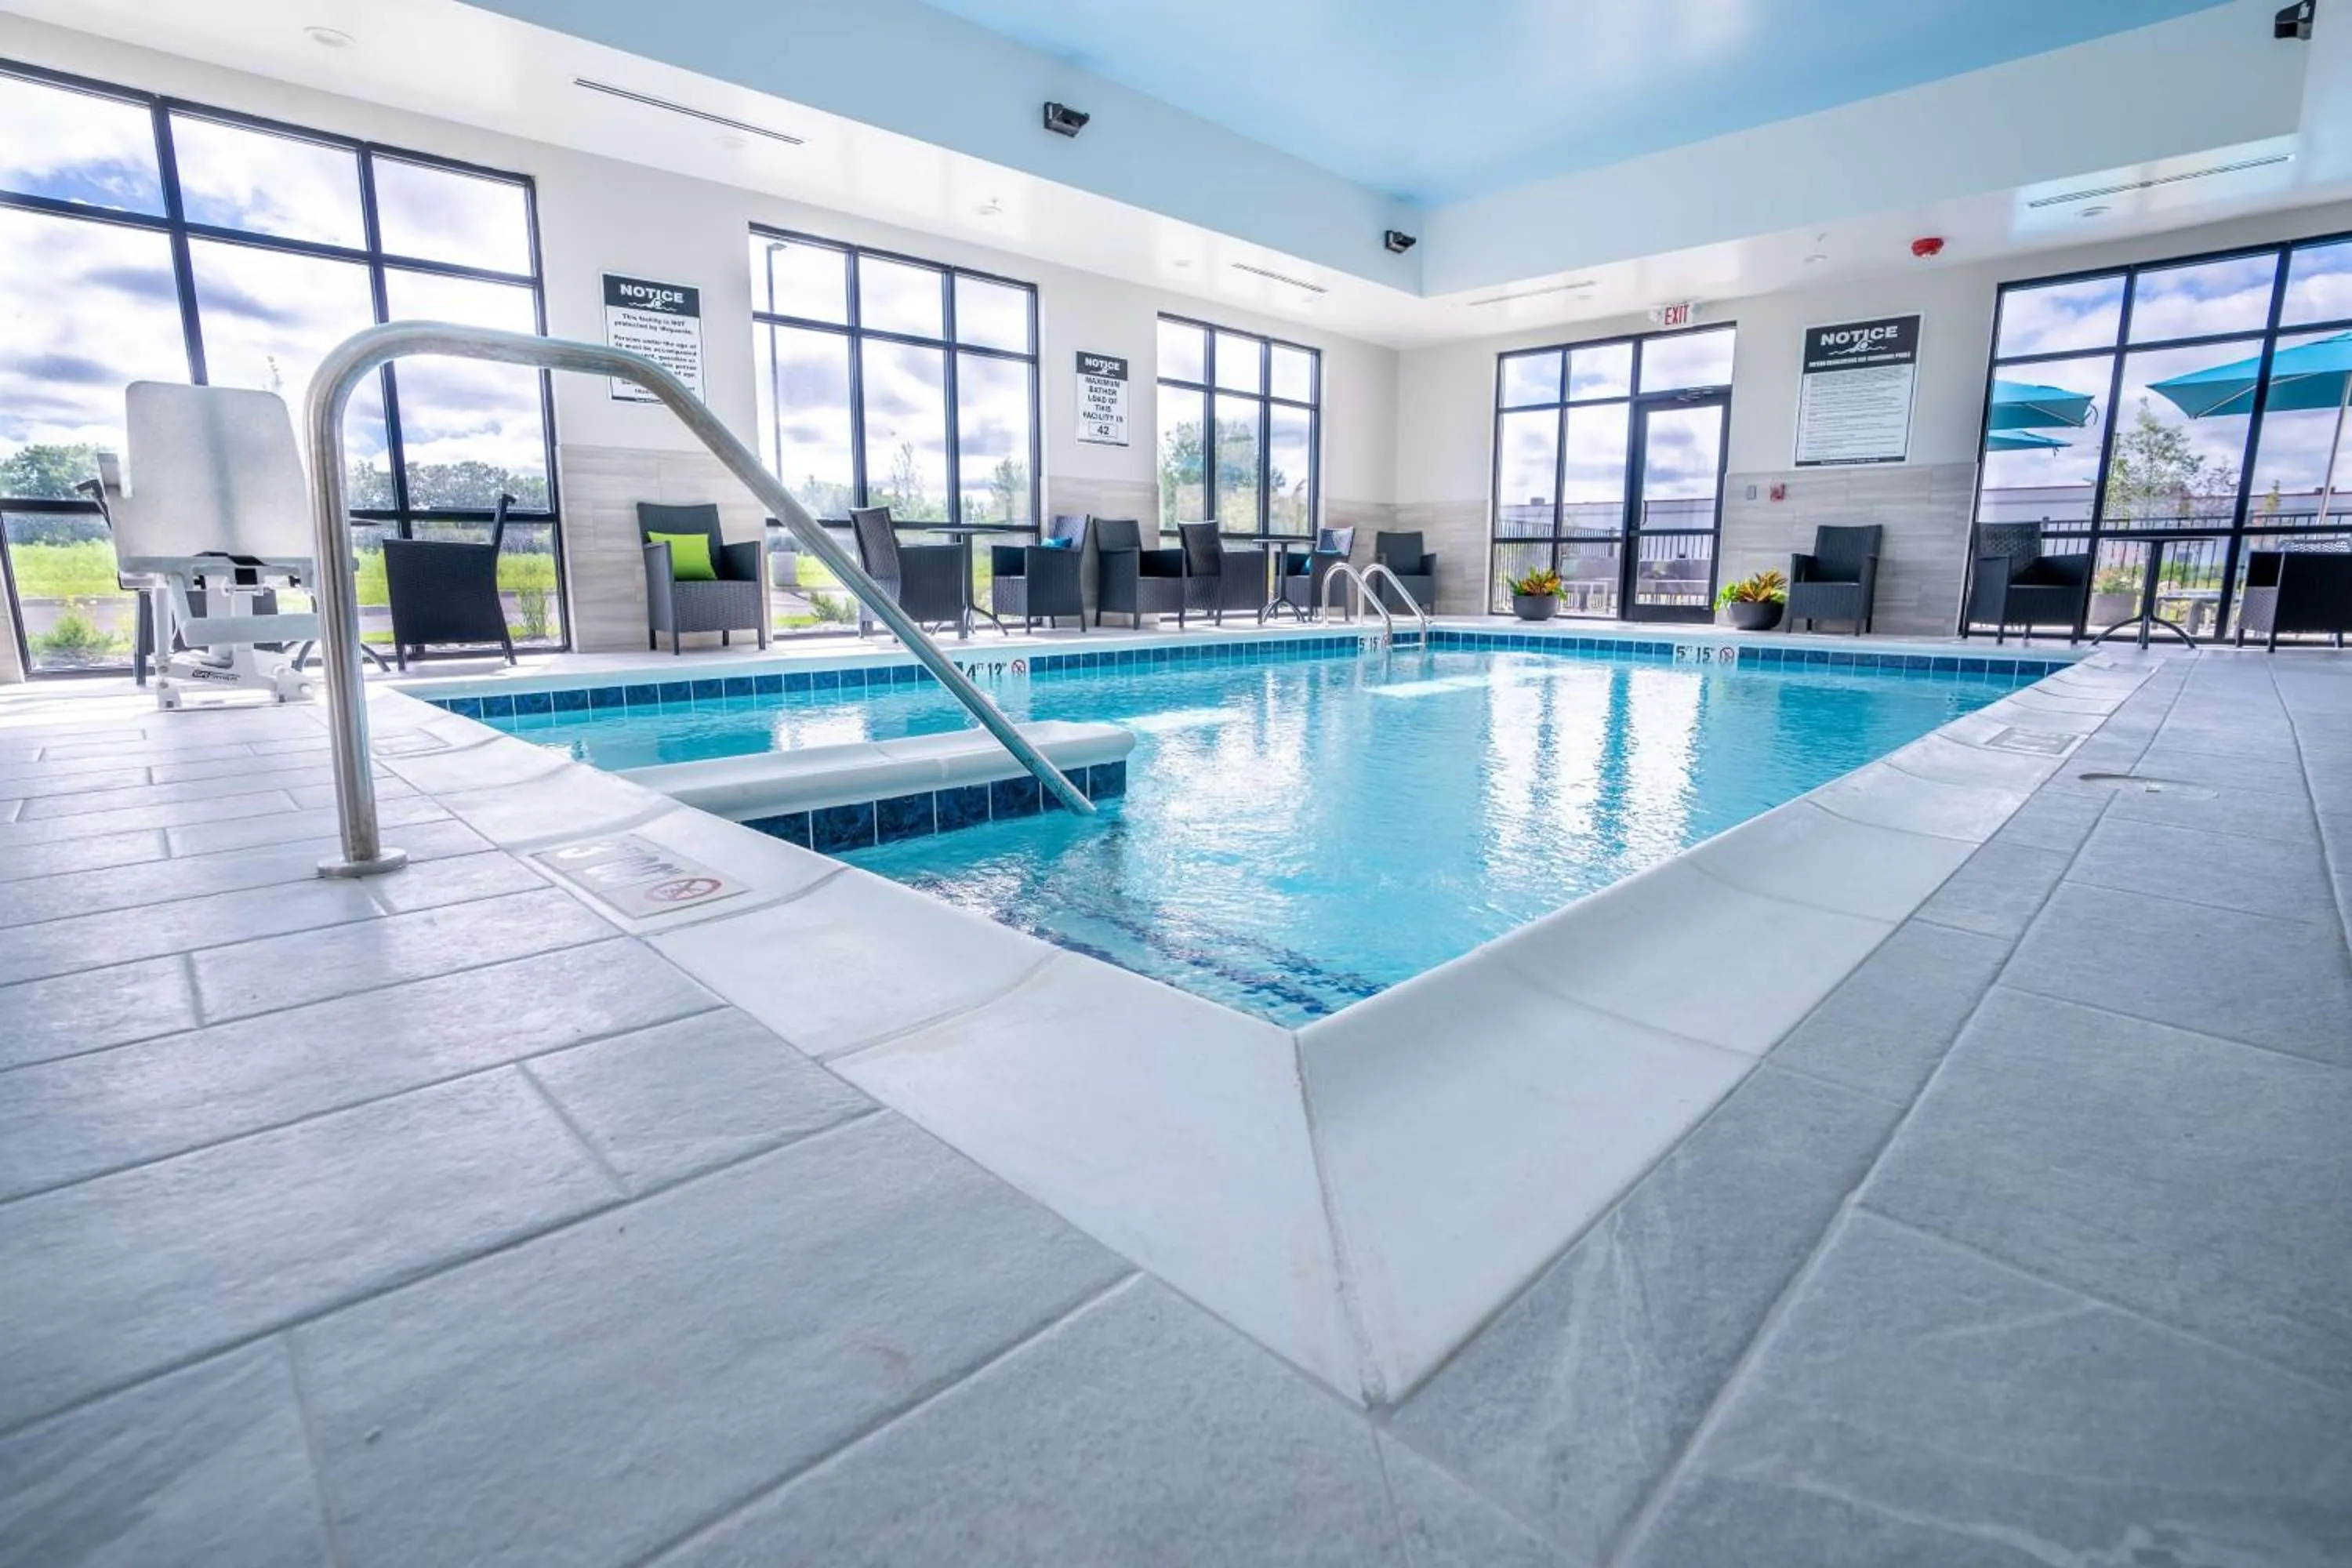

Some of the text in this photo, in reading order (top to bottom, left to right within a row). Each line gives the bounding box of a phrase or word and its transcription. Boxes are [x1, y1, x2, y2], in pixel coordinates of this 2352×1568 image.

[620, 283, 684, 303] NOTICE
[1664, 304, 1689, 325] EXIT
[1820, 325, 1898, 346] NOTICE
[1085, 357, 1120, 371] NOTICE
[1098, 425, 1109, 434] 42
